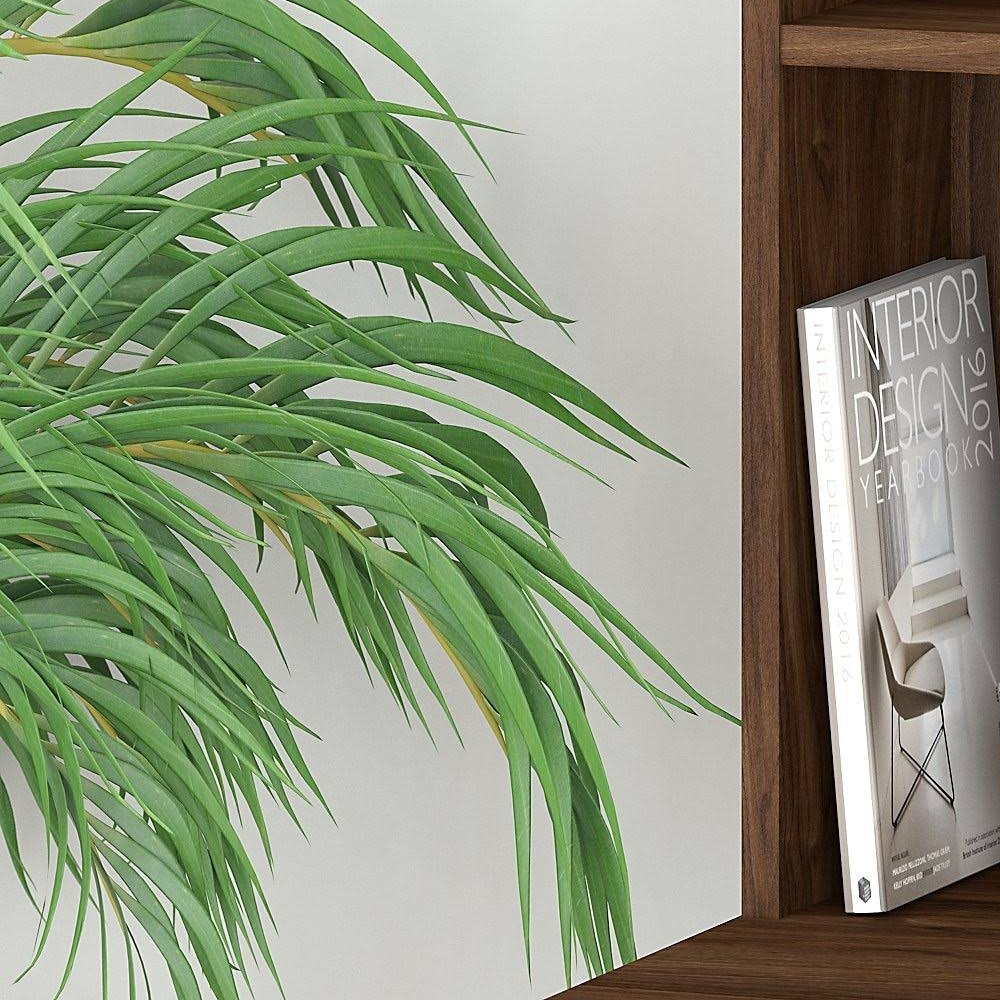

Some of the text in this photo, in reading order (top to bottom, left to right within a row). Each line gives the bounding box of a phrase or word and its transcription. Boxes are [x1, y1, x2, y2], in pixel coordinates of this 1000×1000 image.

[847, 268, 985, 380] INTERIOR
[853, 354, 969, 467] DESIGN
[971, 347, 994, 467] 2016
[859, 435, 973, 509] YEARBOOK
